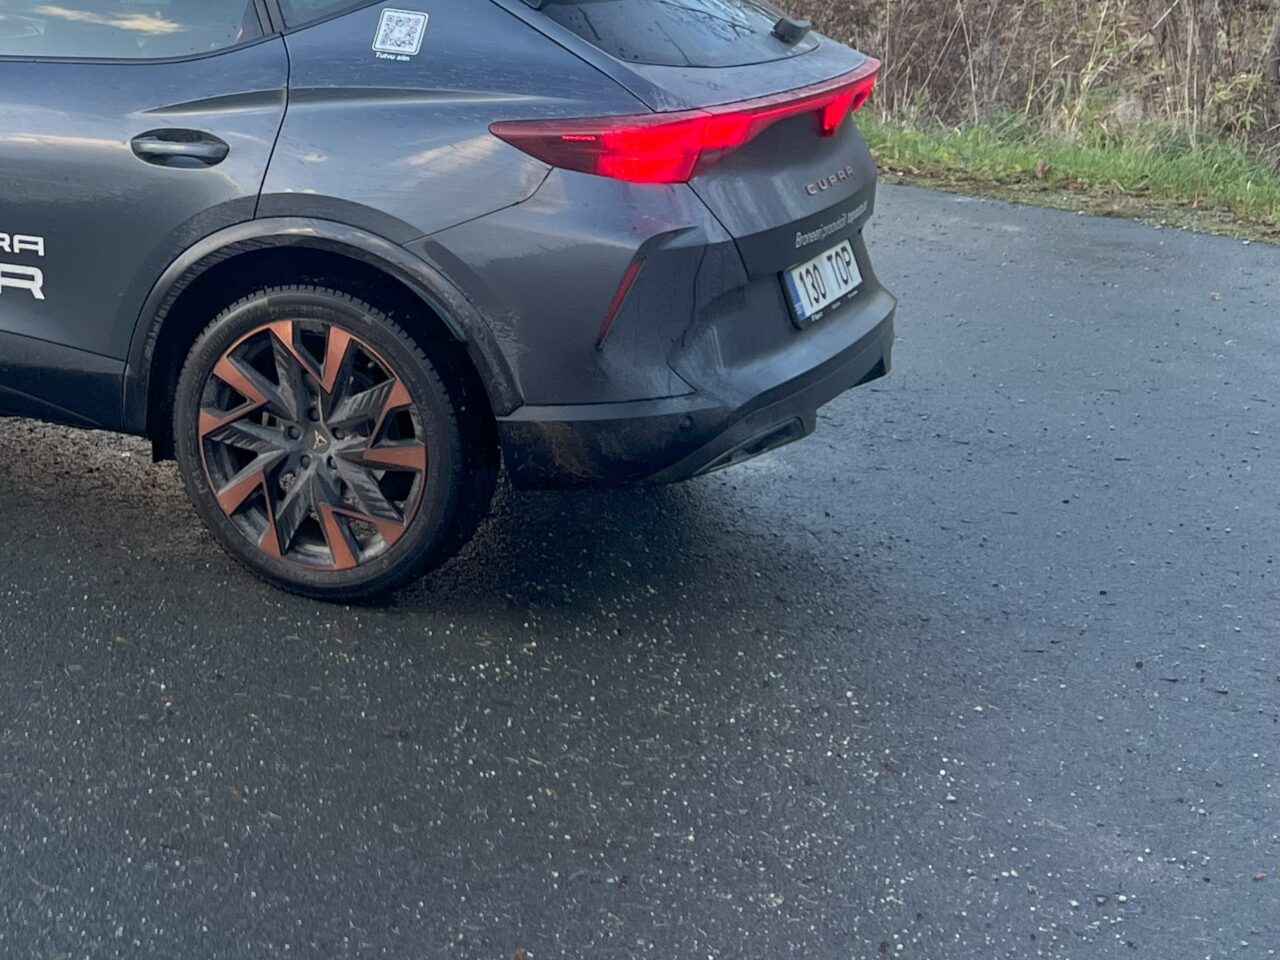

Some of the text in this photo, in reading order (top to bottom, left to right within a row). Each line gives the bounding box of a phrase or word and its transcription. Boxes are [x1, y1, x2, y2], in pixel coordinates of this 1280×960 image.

[805, 166, 854, 196] CUPRA
[799, 263, 827, 308] 130
[826, 246, 854, 290] TOP
